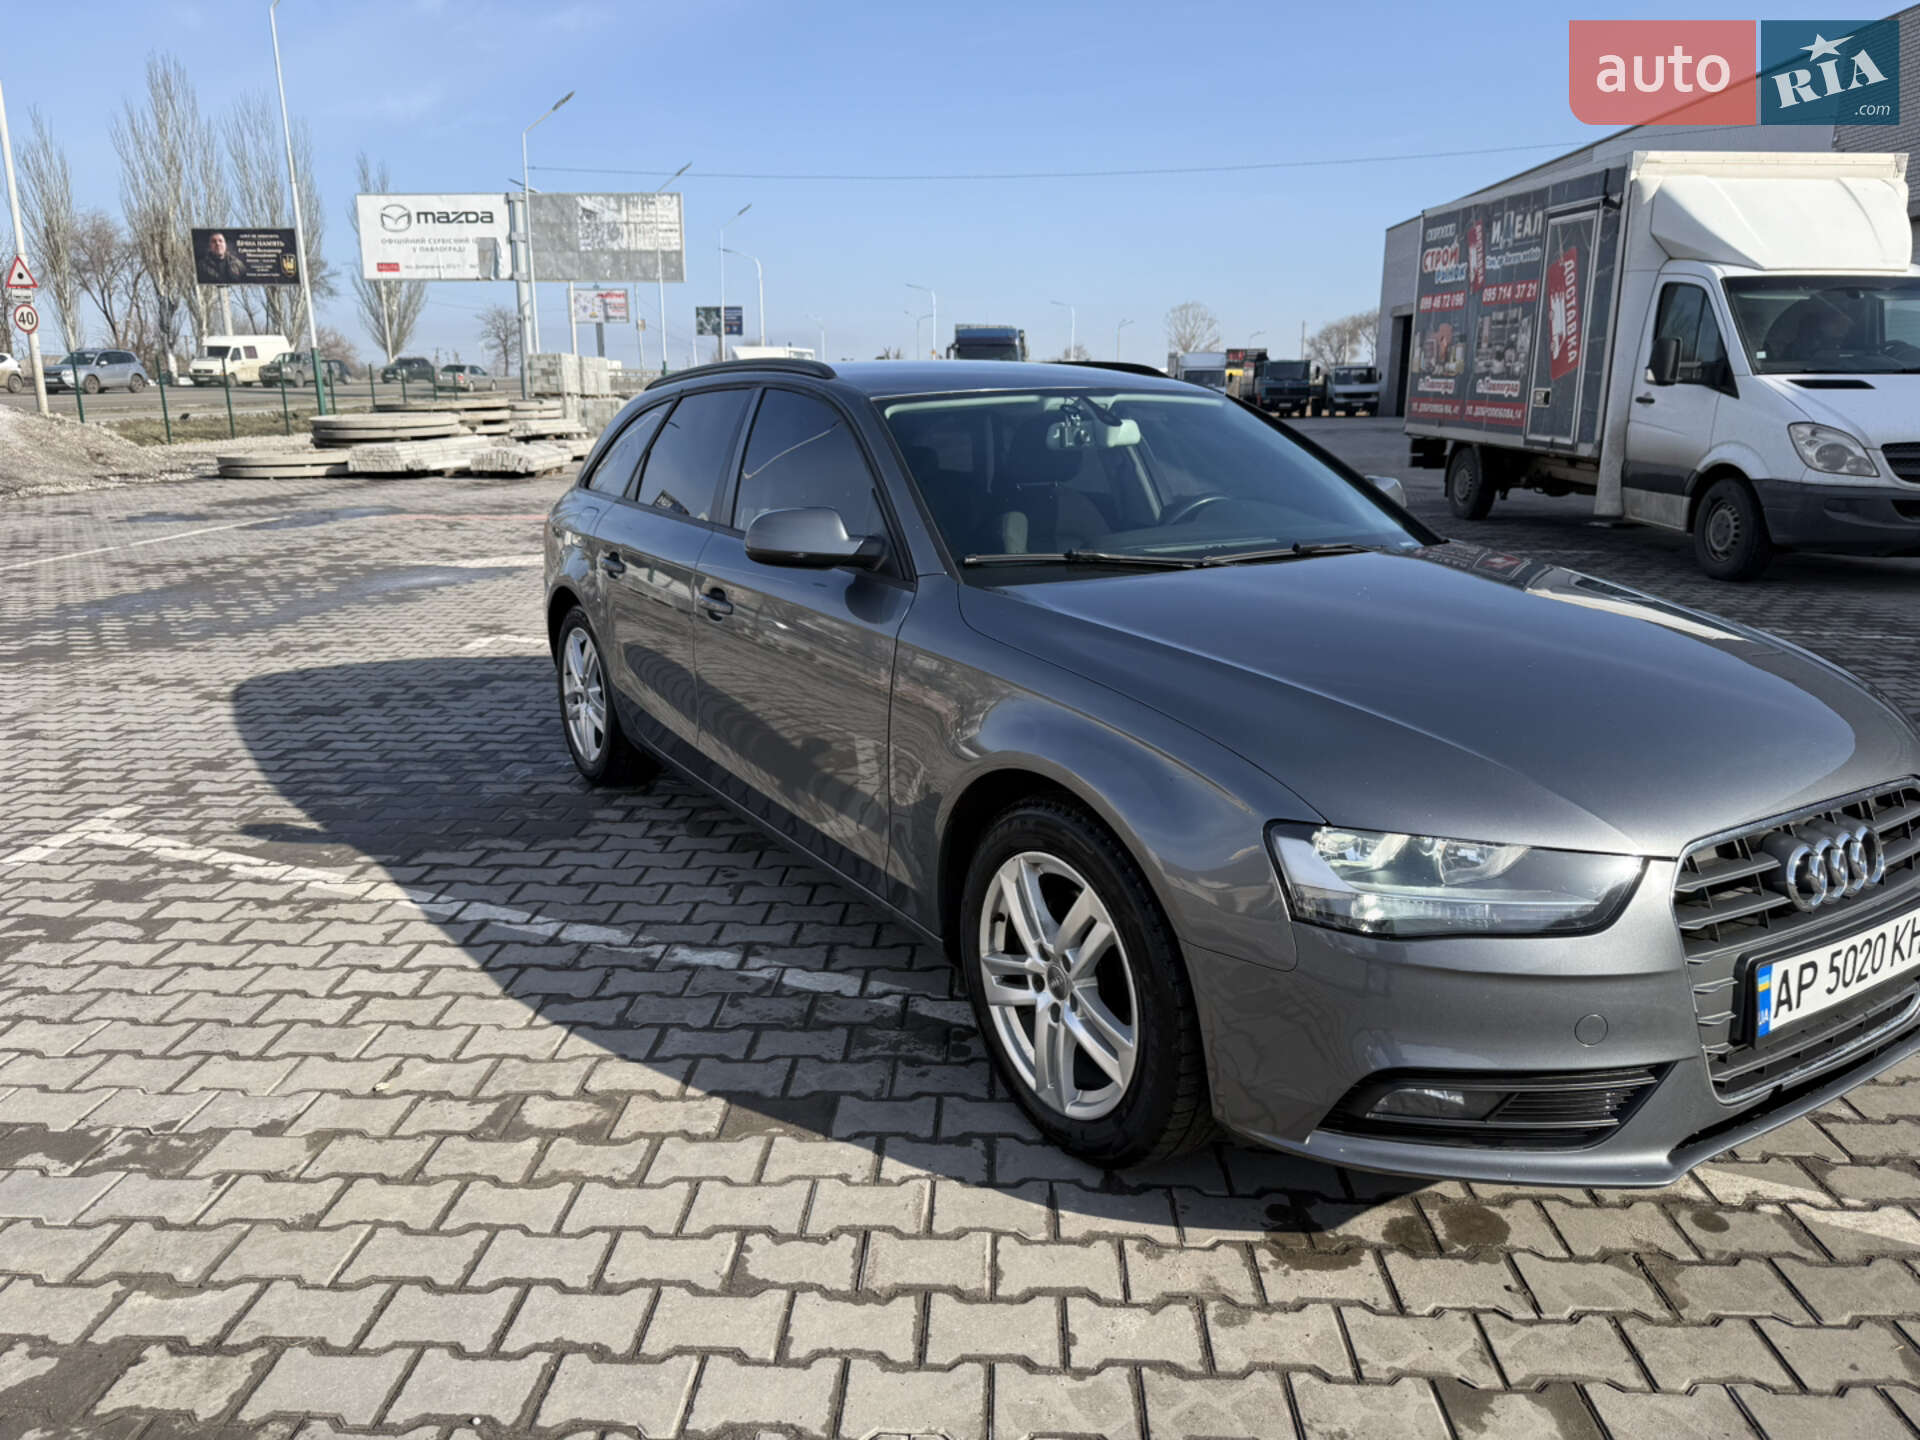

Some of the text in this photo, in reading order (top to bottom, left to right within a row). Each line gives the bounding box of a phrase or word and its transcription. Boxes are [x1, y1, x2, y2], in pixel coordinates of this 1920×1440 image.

[416, 211, 494, 224] mazda
[1423, 241, 1460, 273] СТРОЙ
[18, 311, 35, 326] 40
[1563, 258, 1578, 364] ДОСТАВКА
[1773, 960, 1818, 1019] AP
[1826, 931, 1887, 995] 5020
